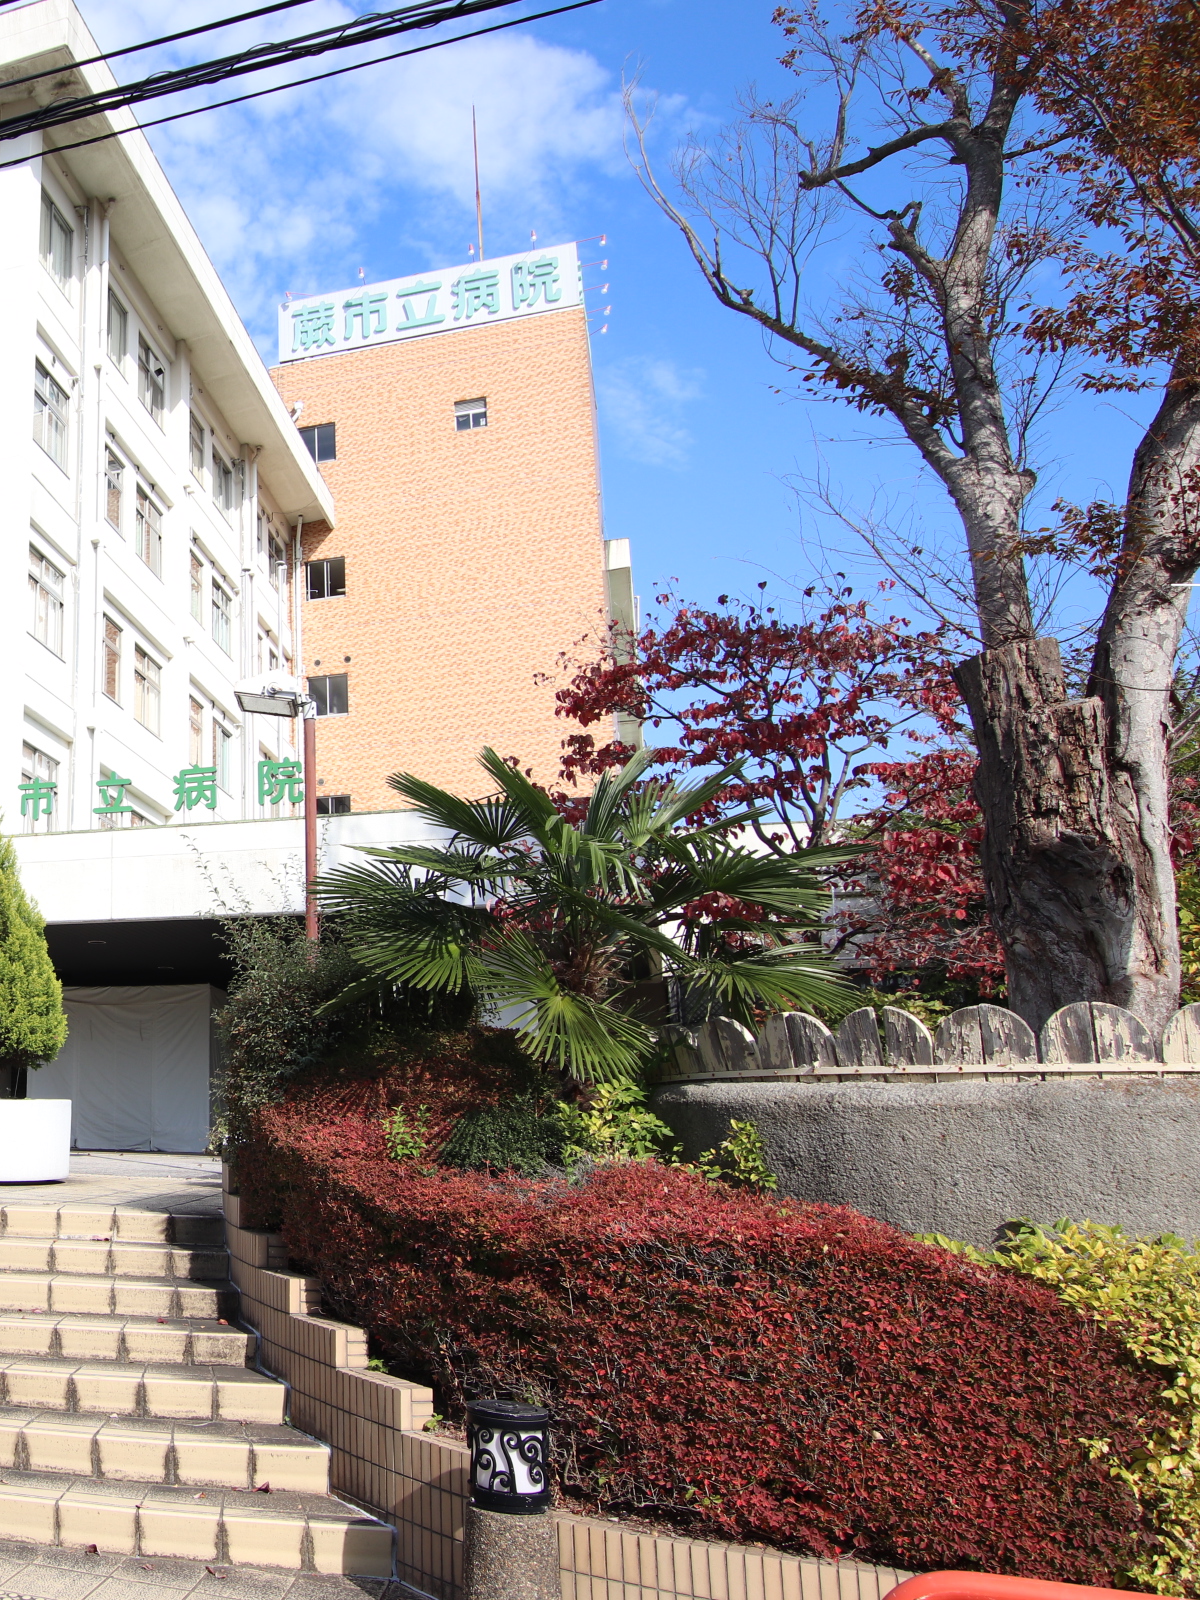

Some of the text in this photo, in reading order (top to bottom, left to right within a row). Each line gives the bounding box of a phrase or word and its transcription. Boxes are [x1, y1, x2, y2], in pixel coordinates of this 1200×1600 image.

[292, 255, 562, 351] 蕨市立病院
